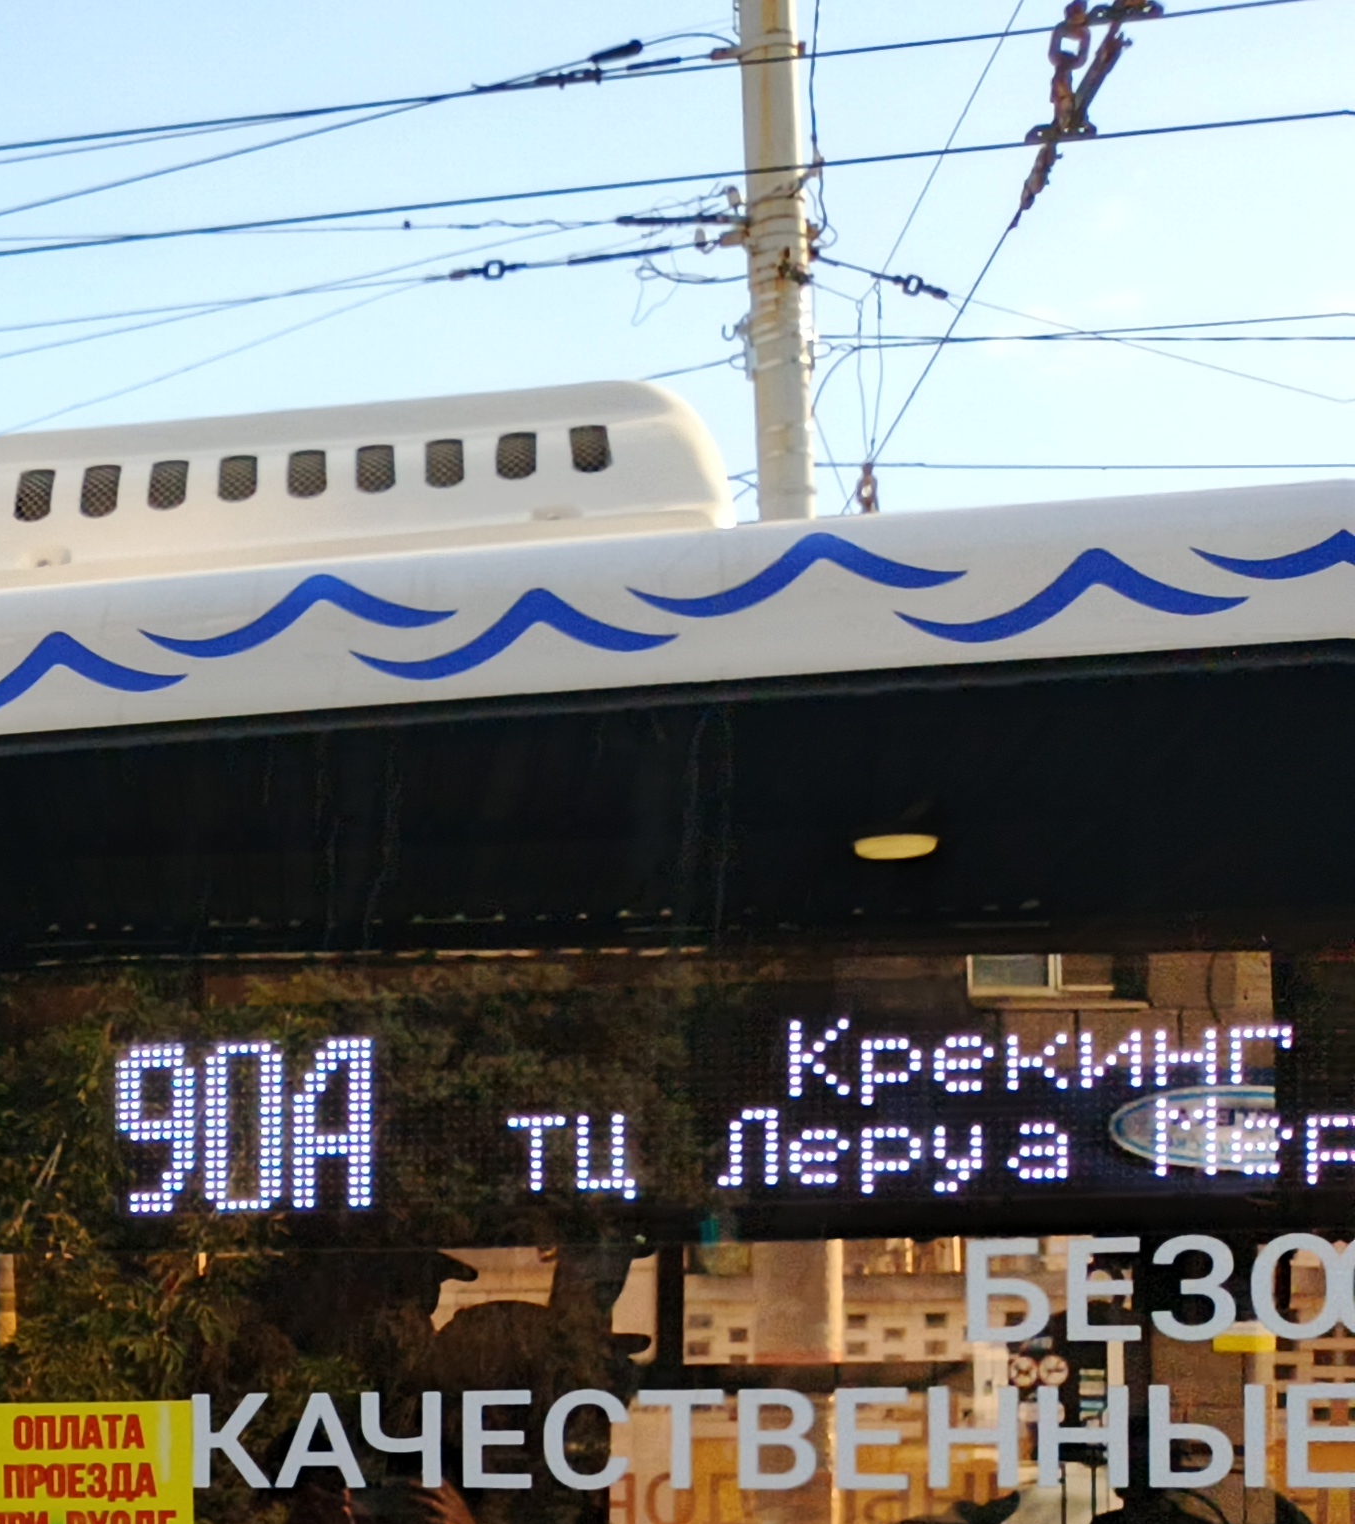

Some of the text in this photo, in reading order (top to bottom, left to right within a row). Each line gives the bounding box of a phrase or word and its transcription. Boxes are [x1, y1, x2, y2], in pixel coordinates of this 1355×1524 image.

[788, 1016, 1294, 1107] Крекинг
[114, 1035, 373, 1214] 90А
[964, 1231, 1355, 1344] БЕЗО
[13, 1413, 145, 1451] ОПЛАТА
[191, 1384, 1355, 1490] КАЧЕСТВЕННЫЕ
[3, 1462, 158, 1502] ПРОЕЗДА
